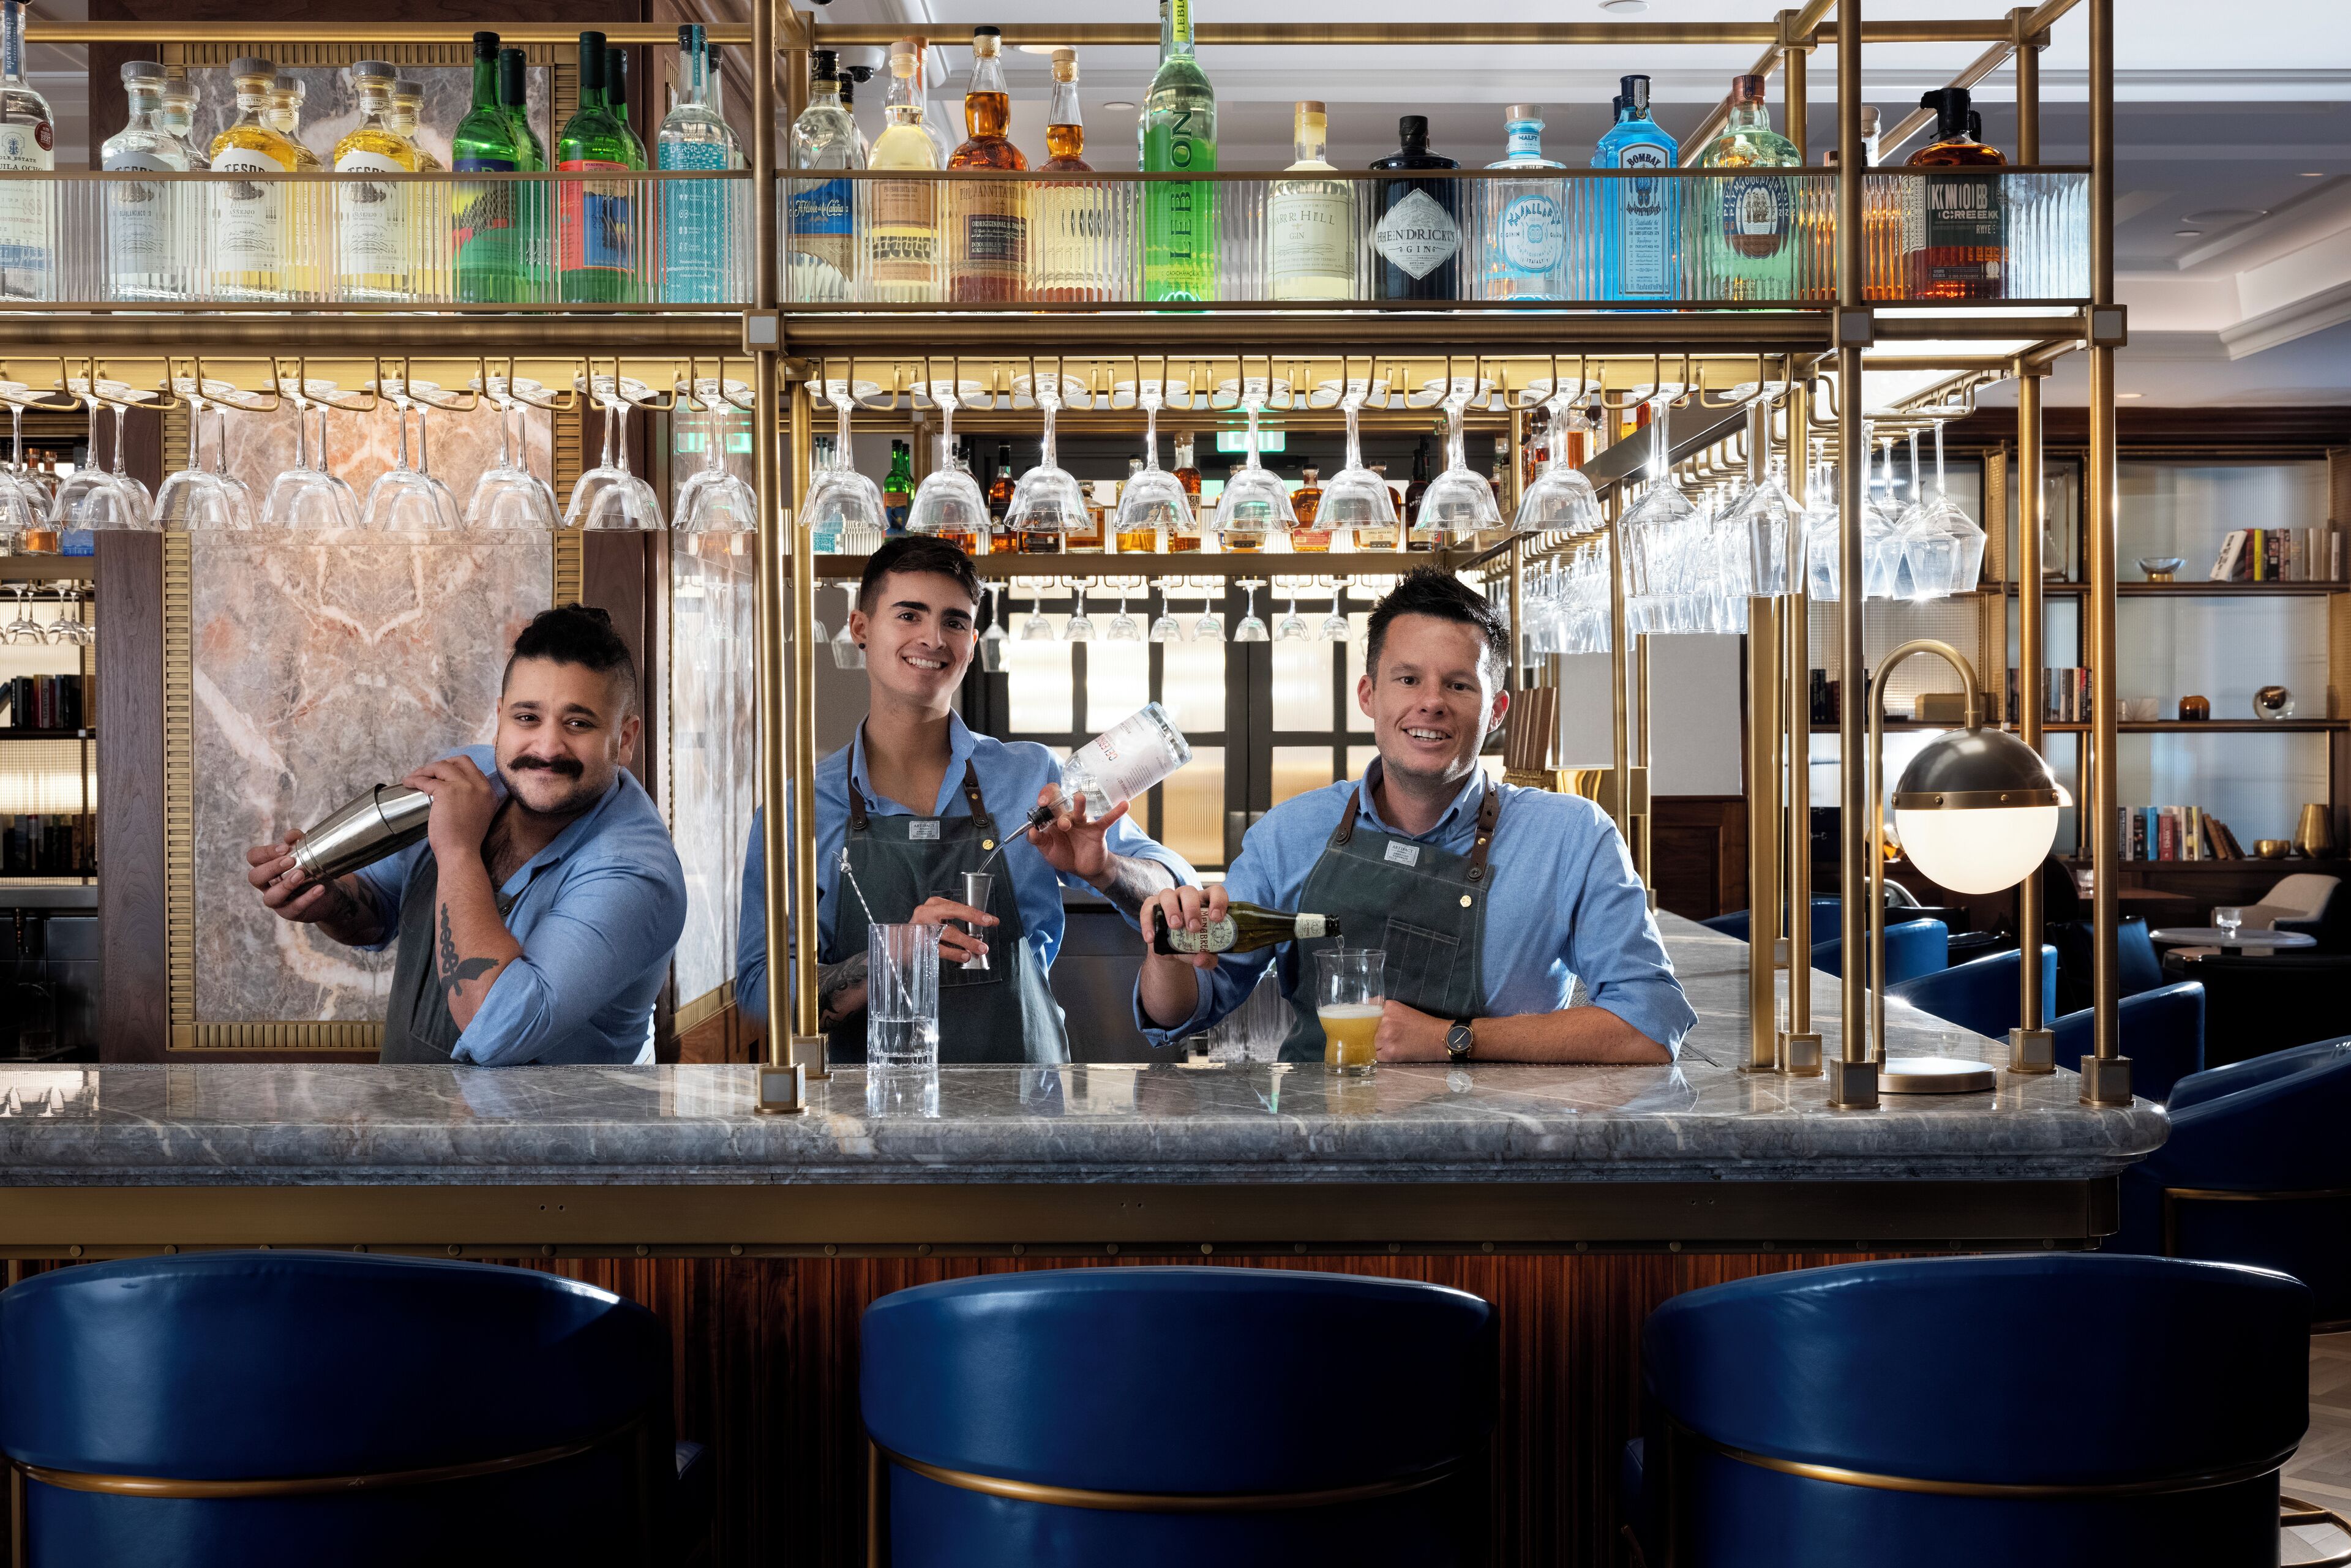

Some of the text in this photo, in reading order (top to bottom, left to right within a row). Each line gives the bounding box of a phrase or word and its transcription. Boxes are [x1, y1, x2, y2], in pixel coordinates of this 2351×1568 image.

[1626, 153, 1662, 168] BOMBAY
[1170, 110, 1193, 260] LEBON
[1930, 184, 1989, 210] KNOB
[1301, 211, 1335, 225] HILL
[1942, 210, 2000, 219] CREEK
[1378, 228, 1455, 242] HENDRICK'S
